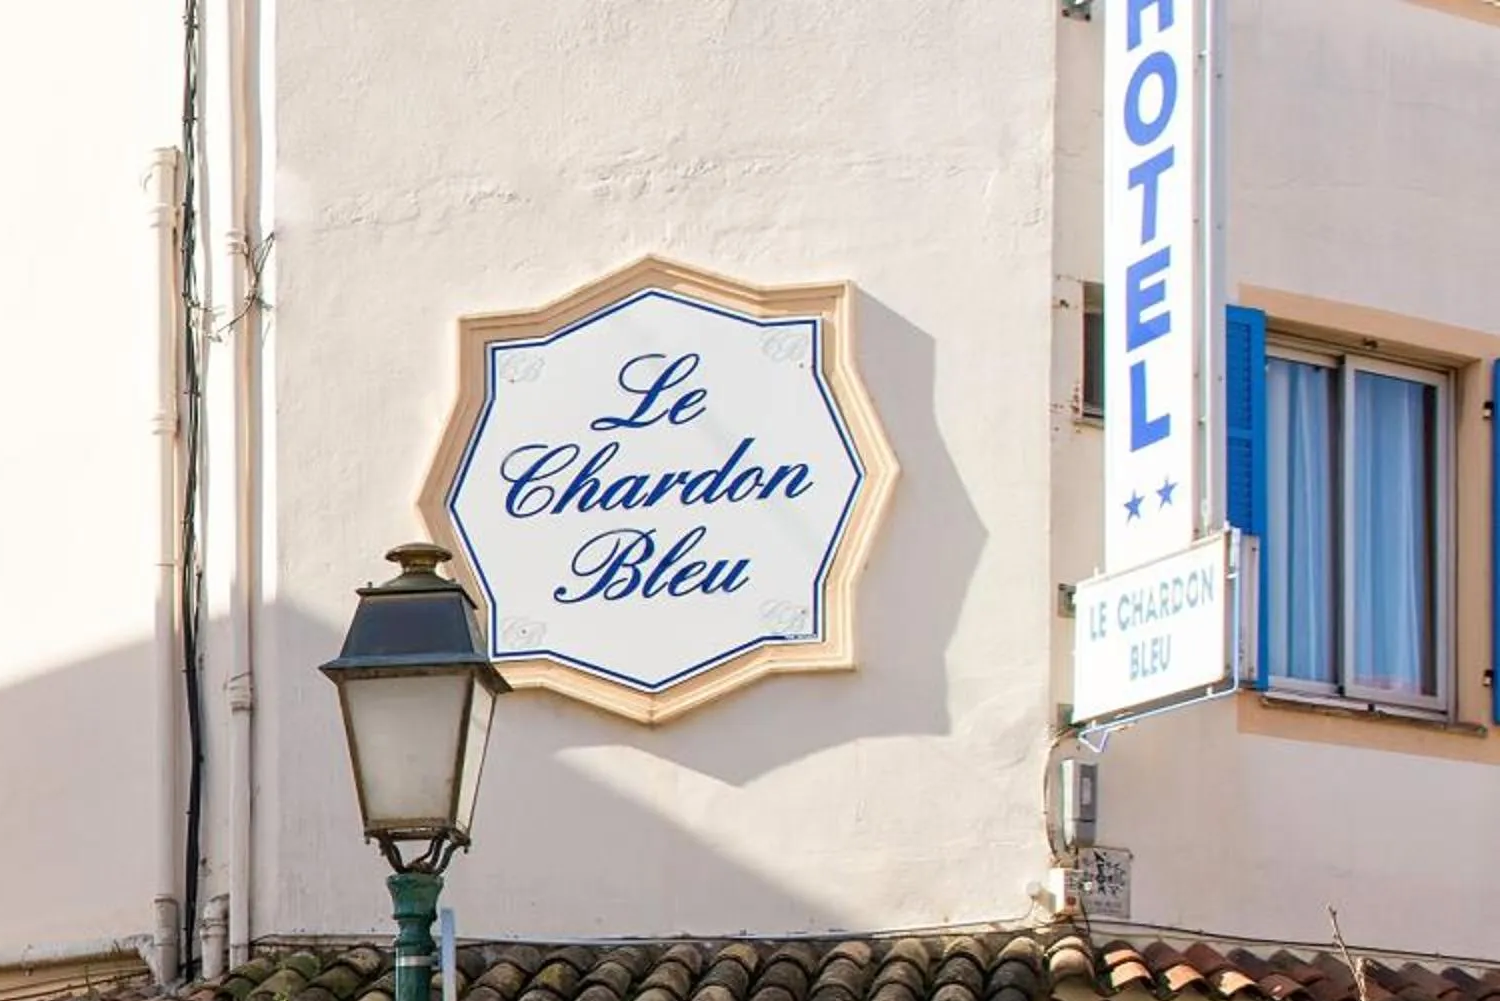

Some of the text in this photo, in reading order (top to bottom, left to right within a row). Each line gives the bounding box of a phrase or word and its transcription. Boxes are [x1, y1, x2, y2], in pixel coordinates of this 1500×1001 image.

[591, 353, 707, 431] Le
[500, 437, 813, 519] Chardon
[553, 526, 750, 603] Bleu
[1089, 564, 1215, 641] LE CHARDON
[1130, 634, 1172, 682] BLEU
